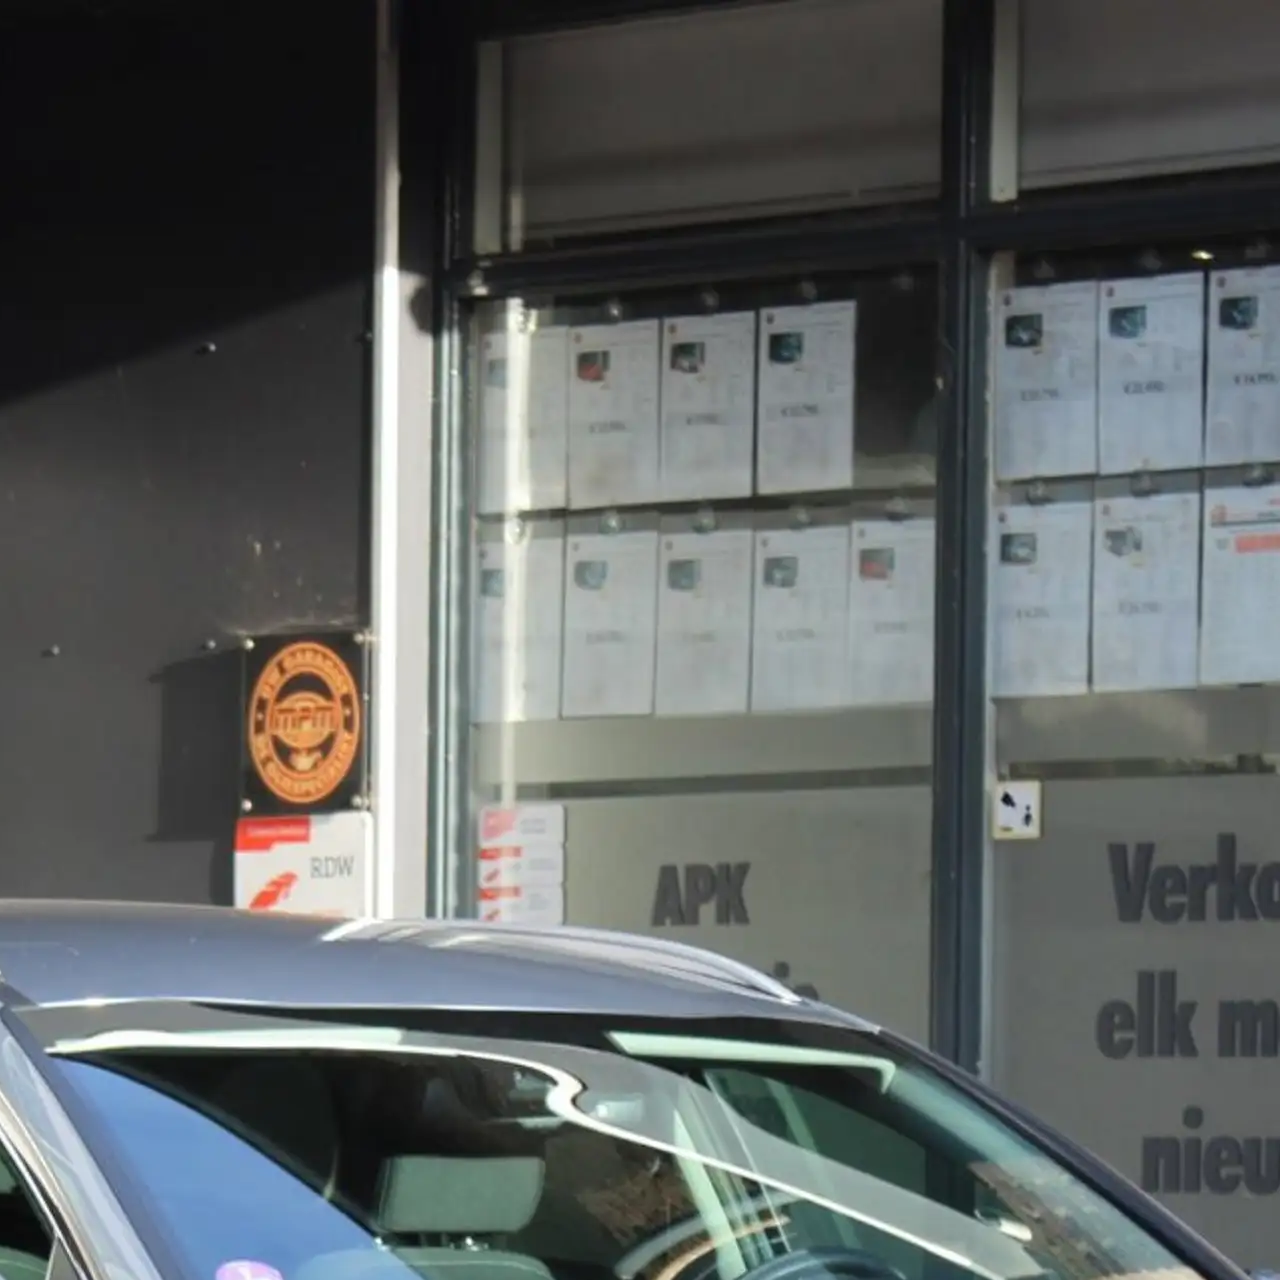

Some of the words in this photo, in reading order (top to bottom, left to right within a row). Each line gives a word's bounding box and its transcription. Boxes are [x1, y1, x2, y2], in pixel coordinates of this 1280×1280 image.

[309, 854, 354, 879] RDW
[651, 861, 752, 926] APK
[1095, 970, 1199, 1060] elk
